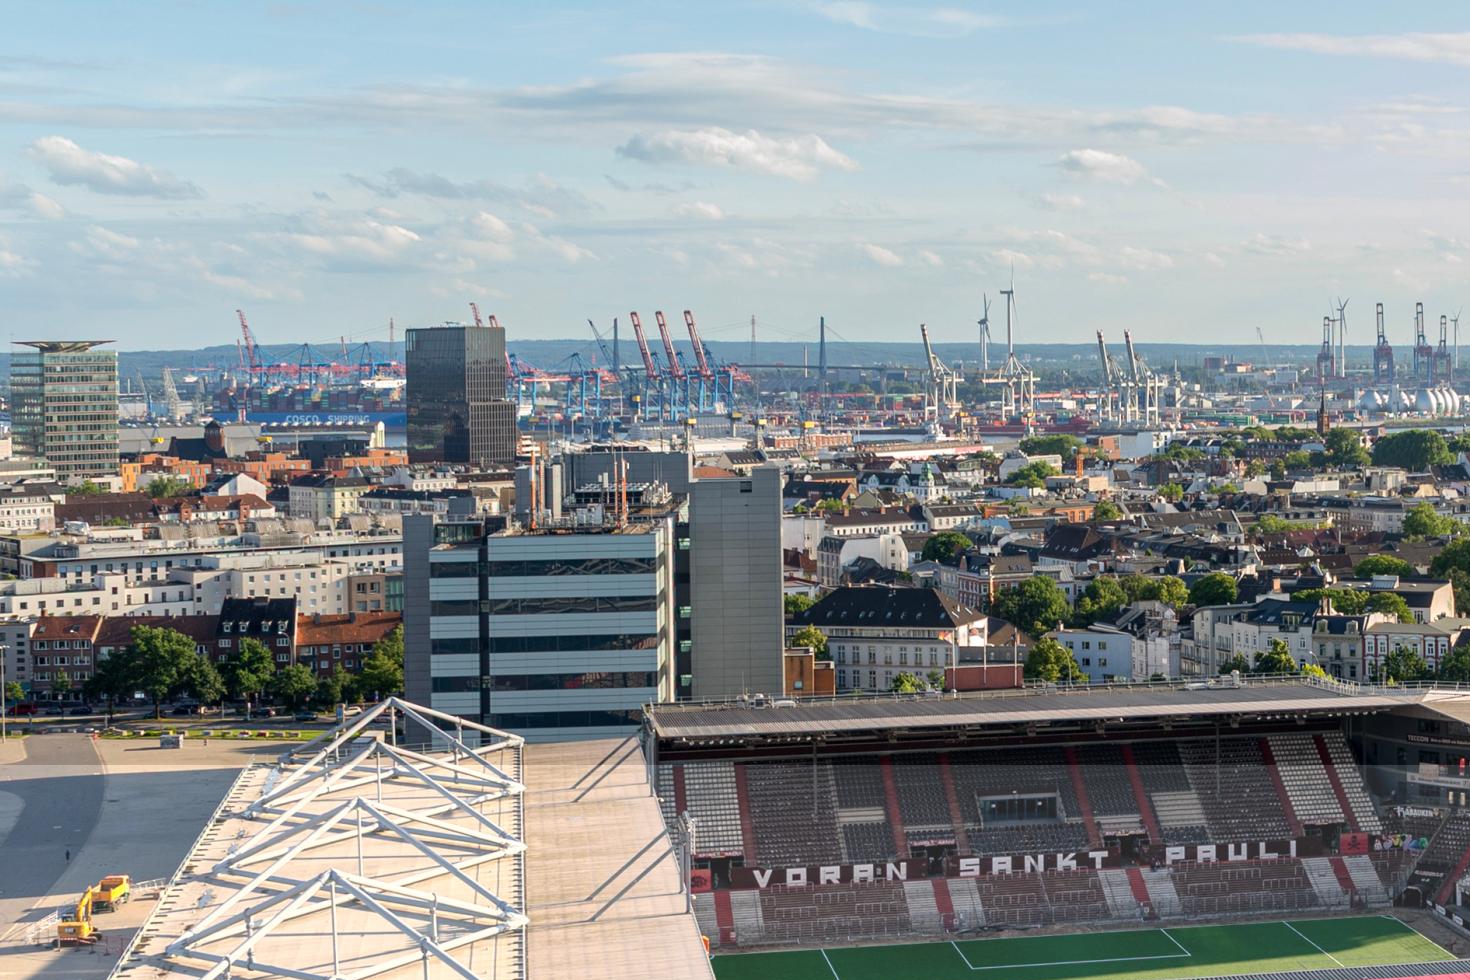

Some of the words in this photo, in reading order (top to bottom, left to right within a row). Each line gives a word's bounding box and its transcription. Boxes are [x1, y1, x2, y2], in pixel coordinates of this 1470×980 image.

[286, 415, 319, 424] COSCO
[328, 415, 370, 424] SHIPPING
[753, 862, 907, 889] VORAN
[959, 850, 1109, 877] SANKT
[1166, 840, 1297, 865] PAULI
